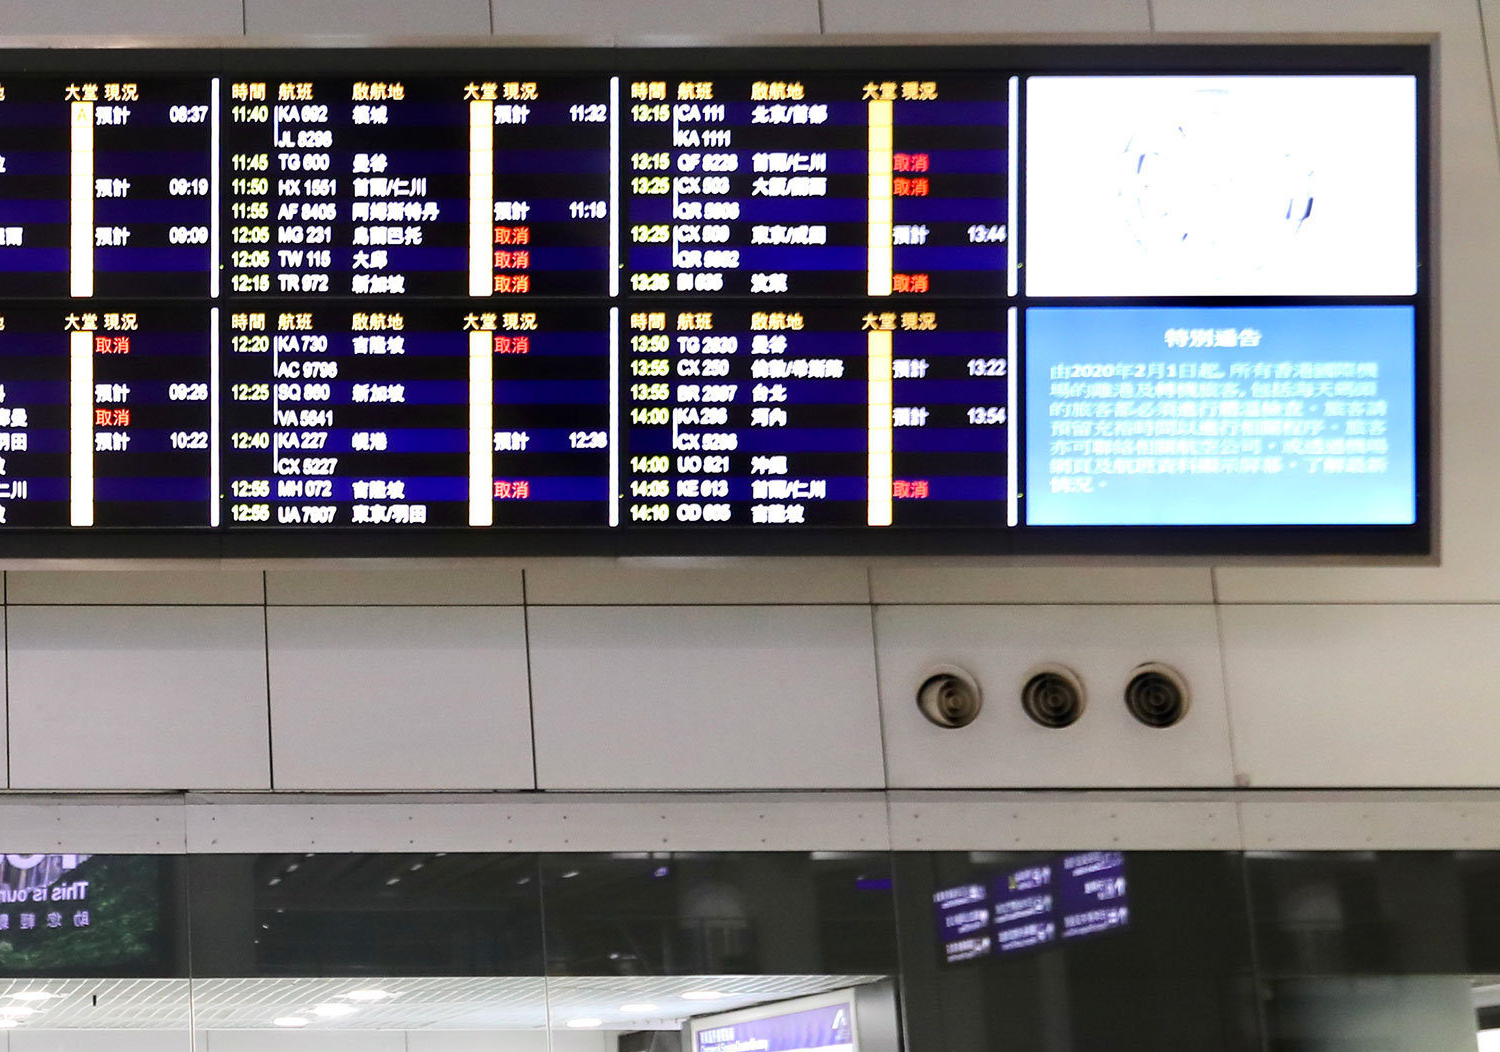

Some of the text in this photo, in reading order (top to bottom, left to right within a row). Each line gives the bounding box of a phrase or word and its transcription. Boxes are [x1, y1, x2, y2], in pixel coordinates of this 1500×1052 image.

[631, 82, 666, 100] 時間
[678, 82, 713, 100] 航班
[232, 251, 269, 267] 12:05
[278, 250, 303, 267] TW
[498, 251, 529, 268] 取消
[65, 313, 98, 330] 大堂
[232, 336, 269, 352] 12:20
[277, 336, 299, 352] KA
[301, 336, 327, 352] 730
[498, 336, 529, 353] 取消
[171, 432, 208, 448] 10:22
